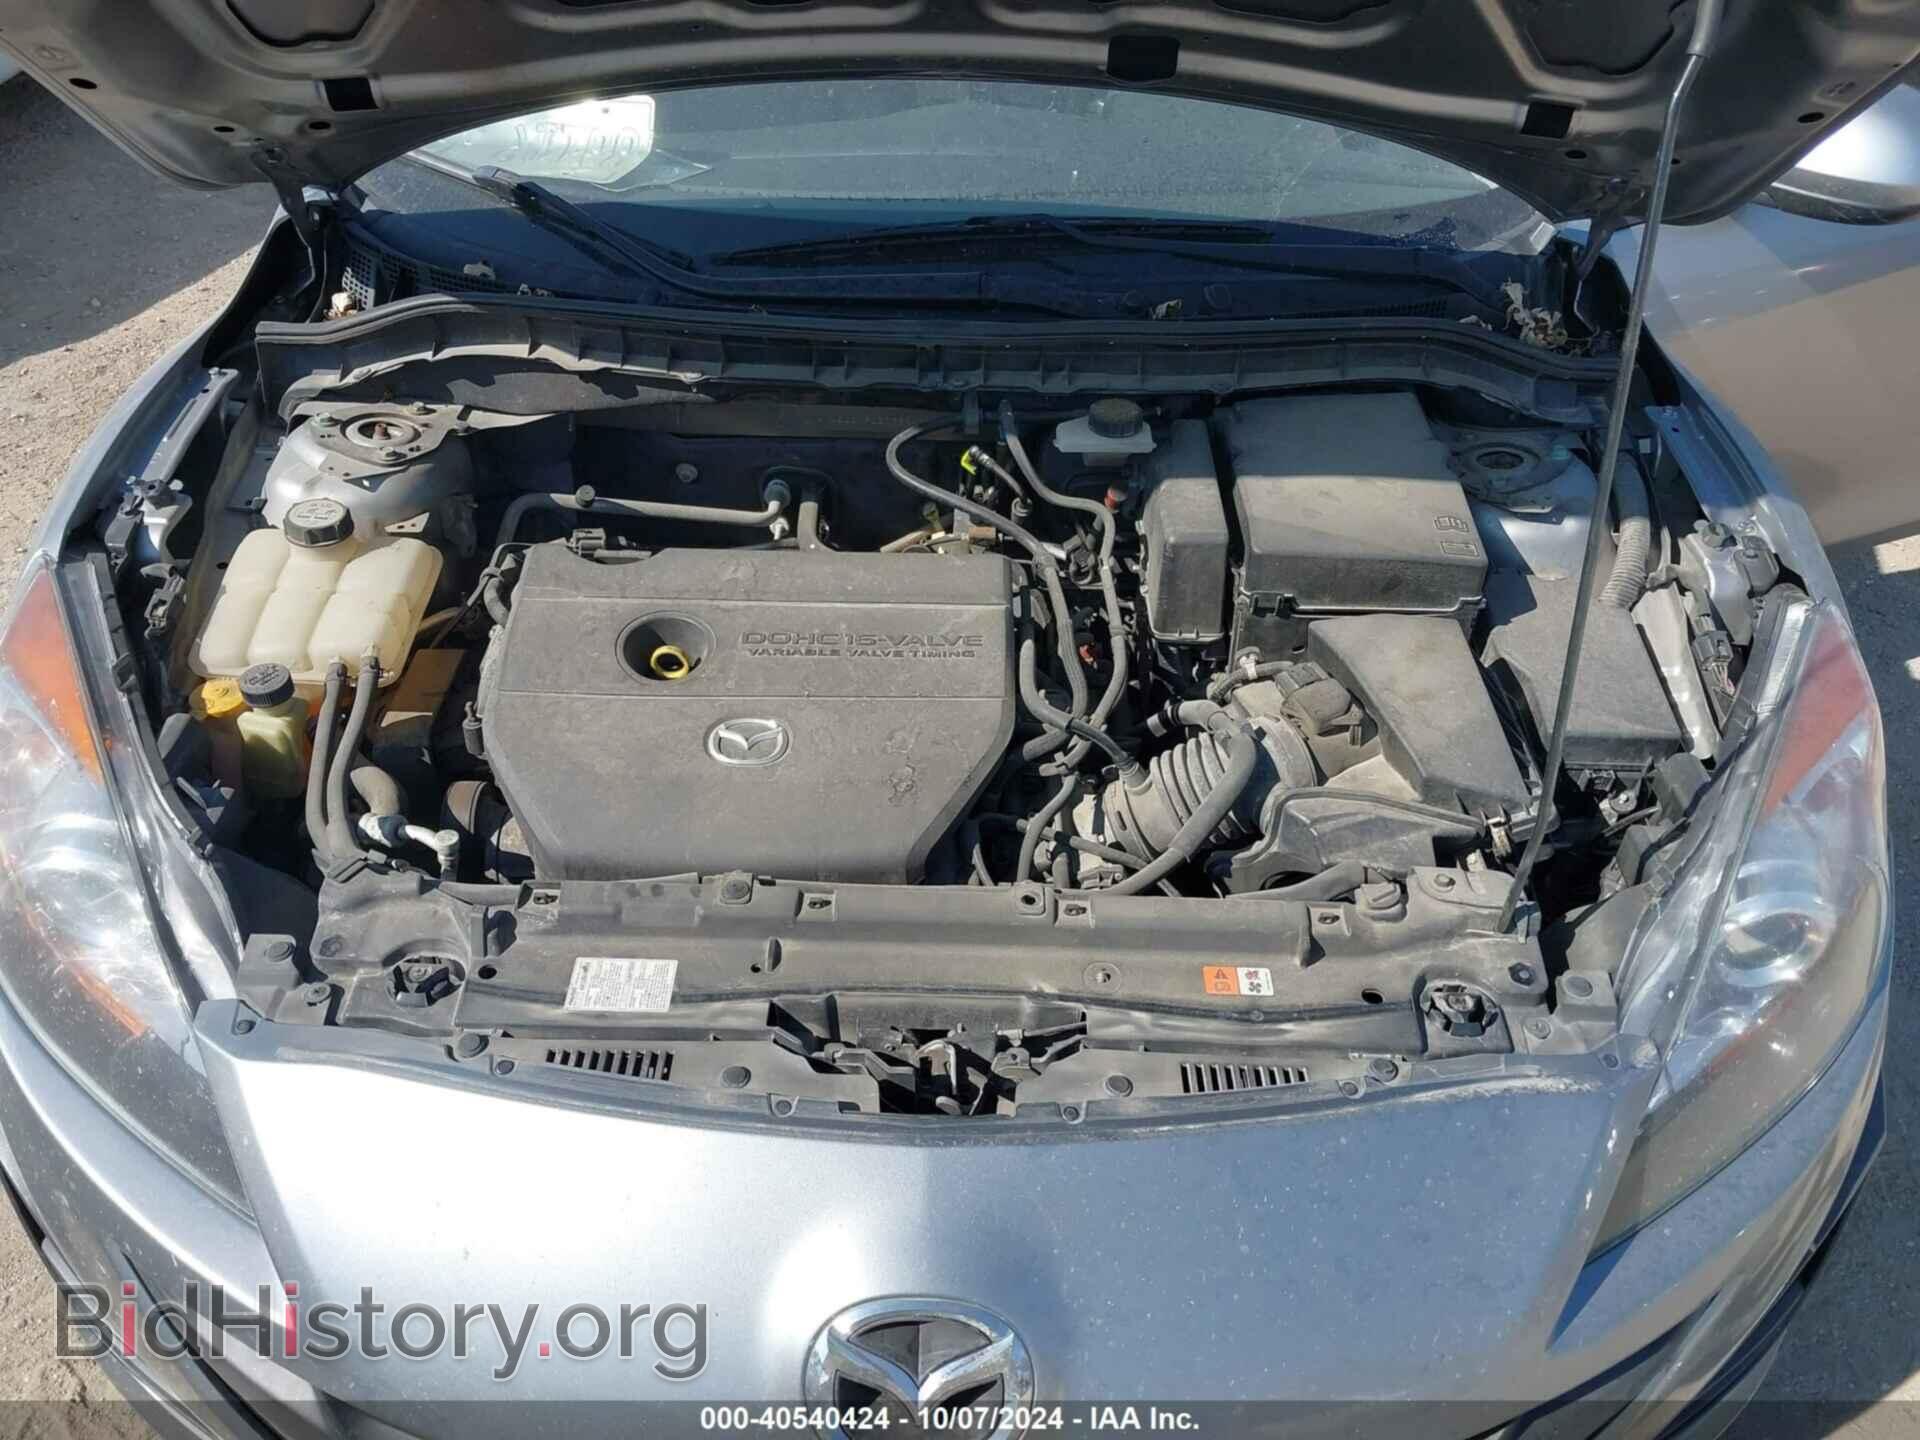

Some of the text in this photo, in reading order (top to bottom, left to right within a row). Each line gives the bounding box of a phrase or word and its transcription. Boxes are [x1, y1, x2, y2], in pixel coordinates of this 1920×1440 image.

[741, 632, 841, 645] DOHC
[748, 648, 976, 658] VARIABLE VALVE TIMING
